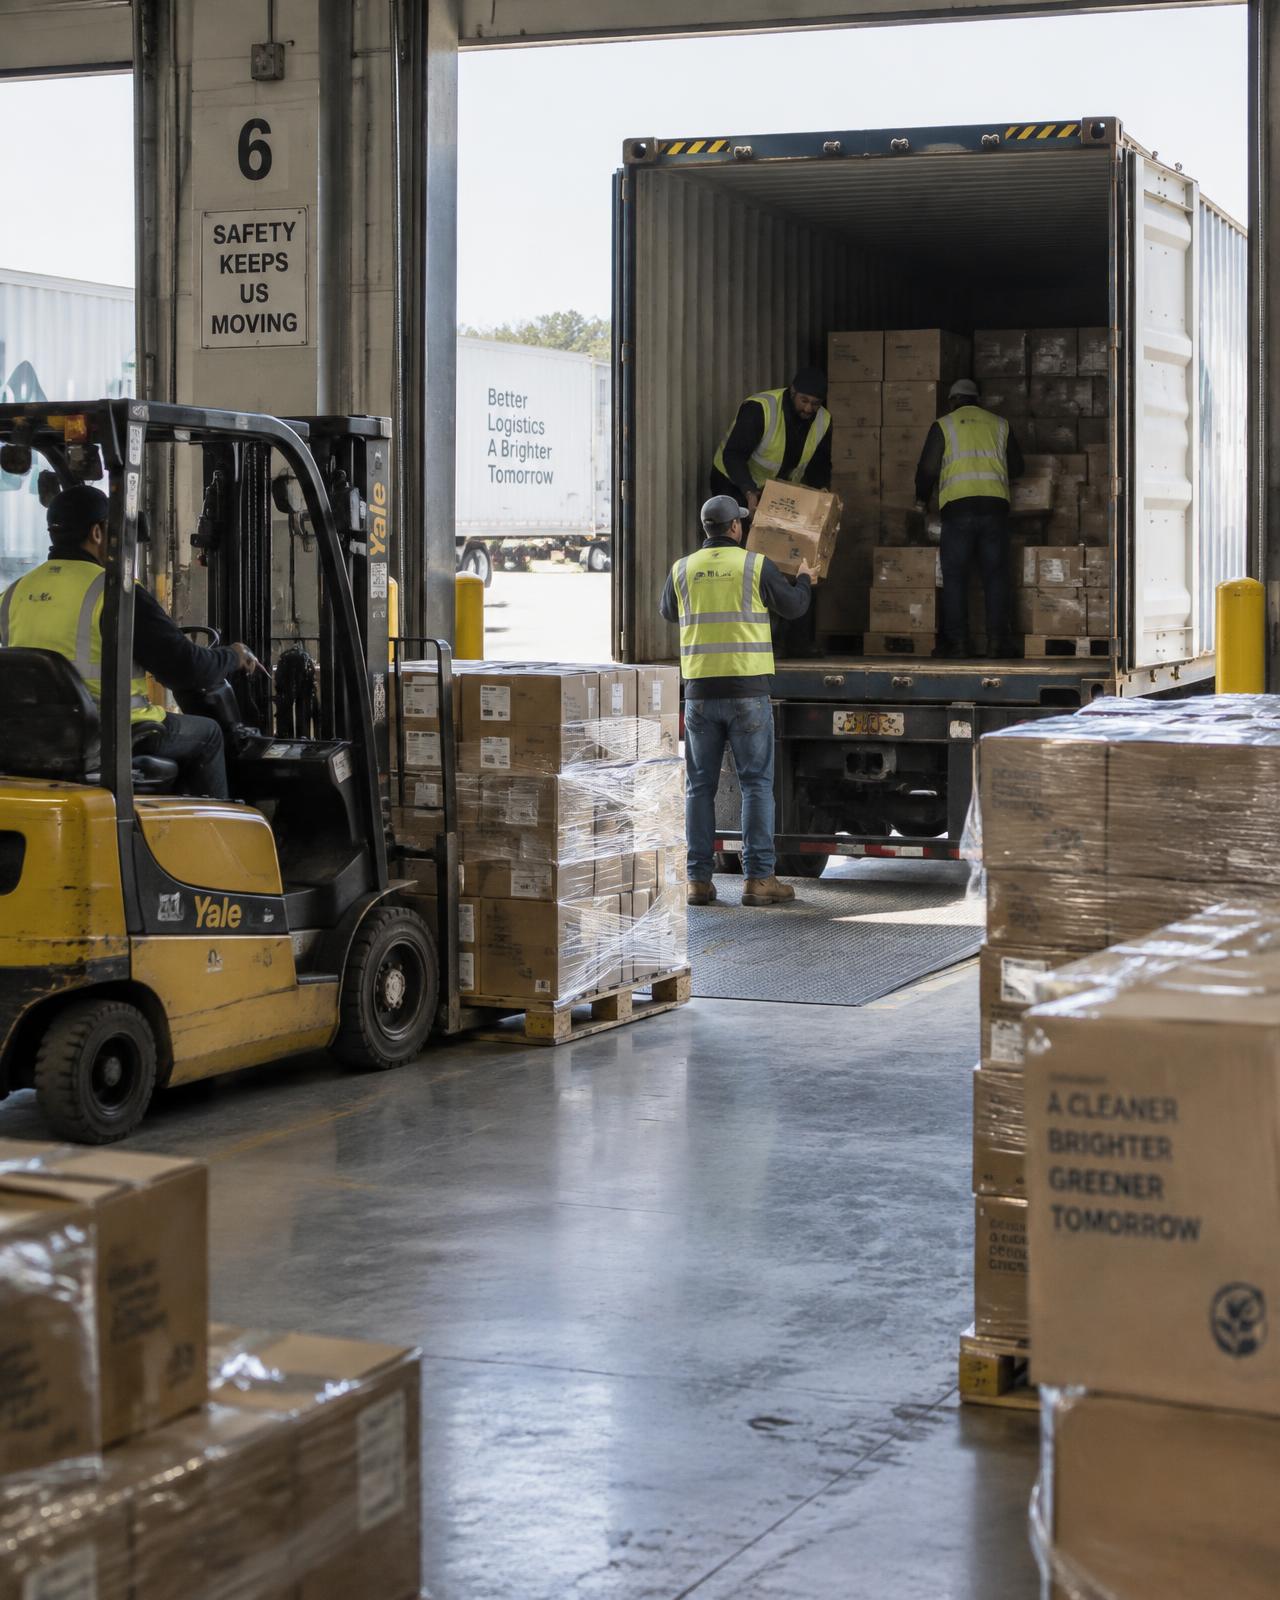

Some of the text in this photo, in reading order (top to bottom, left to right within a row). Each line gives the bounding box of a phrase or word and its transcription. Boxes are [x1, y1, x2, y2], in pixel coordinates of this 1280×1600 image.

[238, 117, 272, 181] 6
[213, 222, 296, 245] SAFETY
[221, 251, 289, 275] KEEPS
[240, 282, 269, 304] US
[211, 312, 298, 335] MOVING
[487, 387, 529, 409] Better
[487, 413, 546, 437] Logistics
[487, 439, 553, 463] A Brighter
[487, 464, 554, 485] Tomorrow
[369, 482, 387, 556] Yale
[193, 895, 242, 929] Yale
[1046, 1091, 1178, 1124] A CLEANER
[1047, 1129, 1173, 1162] BRIGHTER
[1048, 1166, 1164, 1201] GREENER
[1050, 1206, 1202, 1242] TOMORROW
